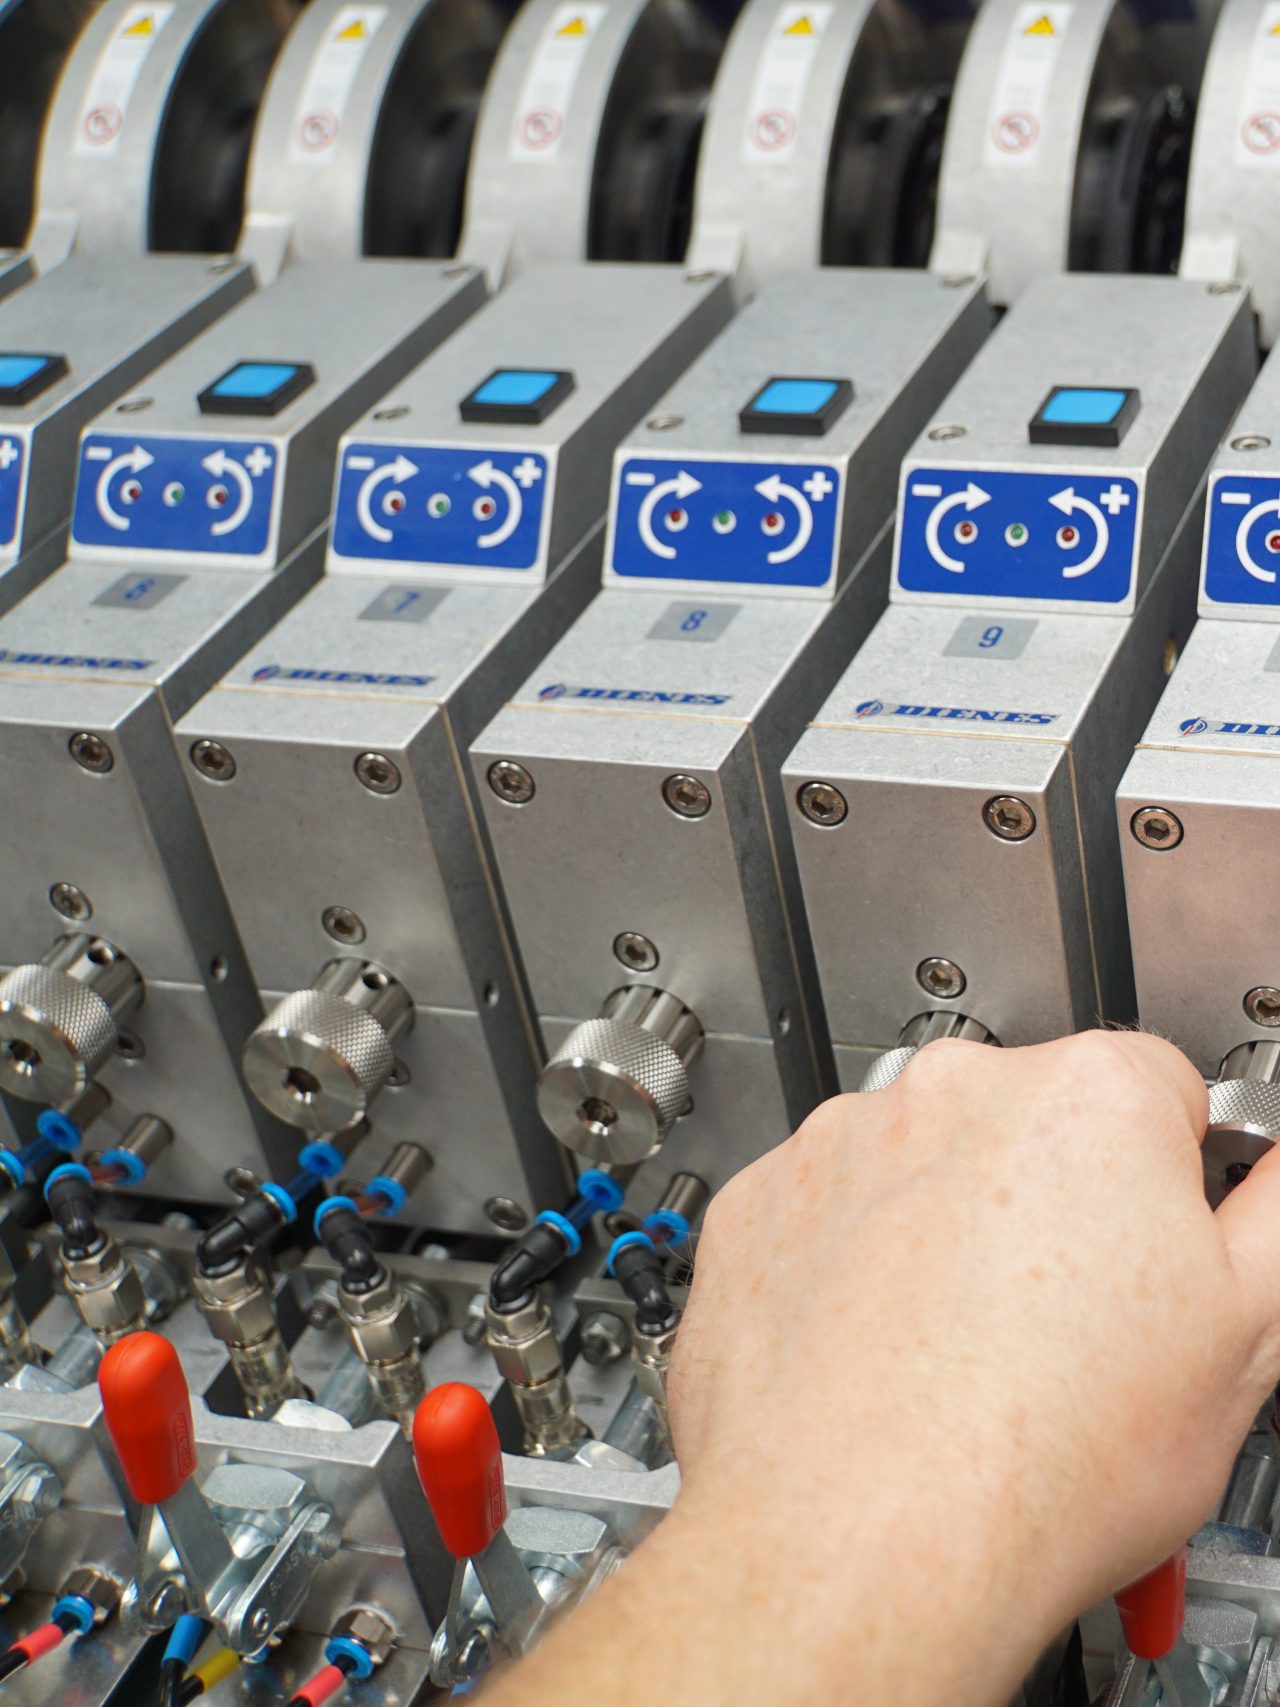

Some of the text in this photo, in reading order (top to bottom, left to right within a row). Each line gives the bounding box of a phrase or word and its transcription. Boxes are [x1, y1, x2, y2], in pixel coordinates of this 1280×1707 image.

[394, 591, 421, 613] 7
[679, 609, 709, 632] 8
[978, 625, 1004, 649] 9
[287, 669, 431, 686] DIENES
[572, 686, 731, 705] DIENES
[889, 704, 1061, 725] DIENES
